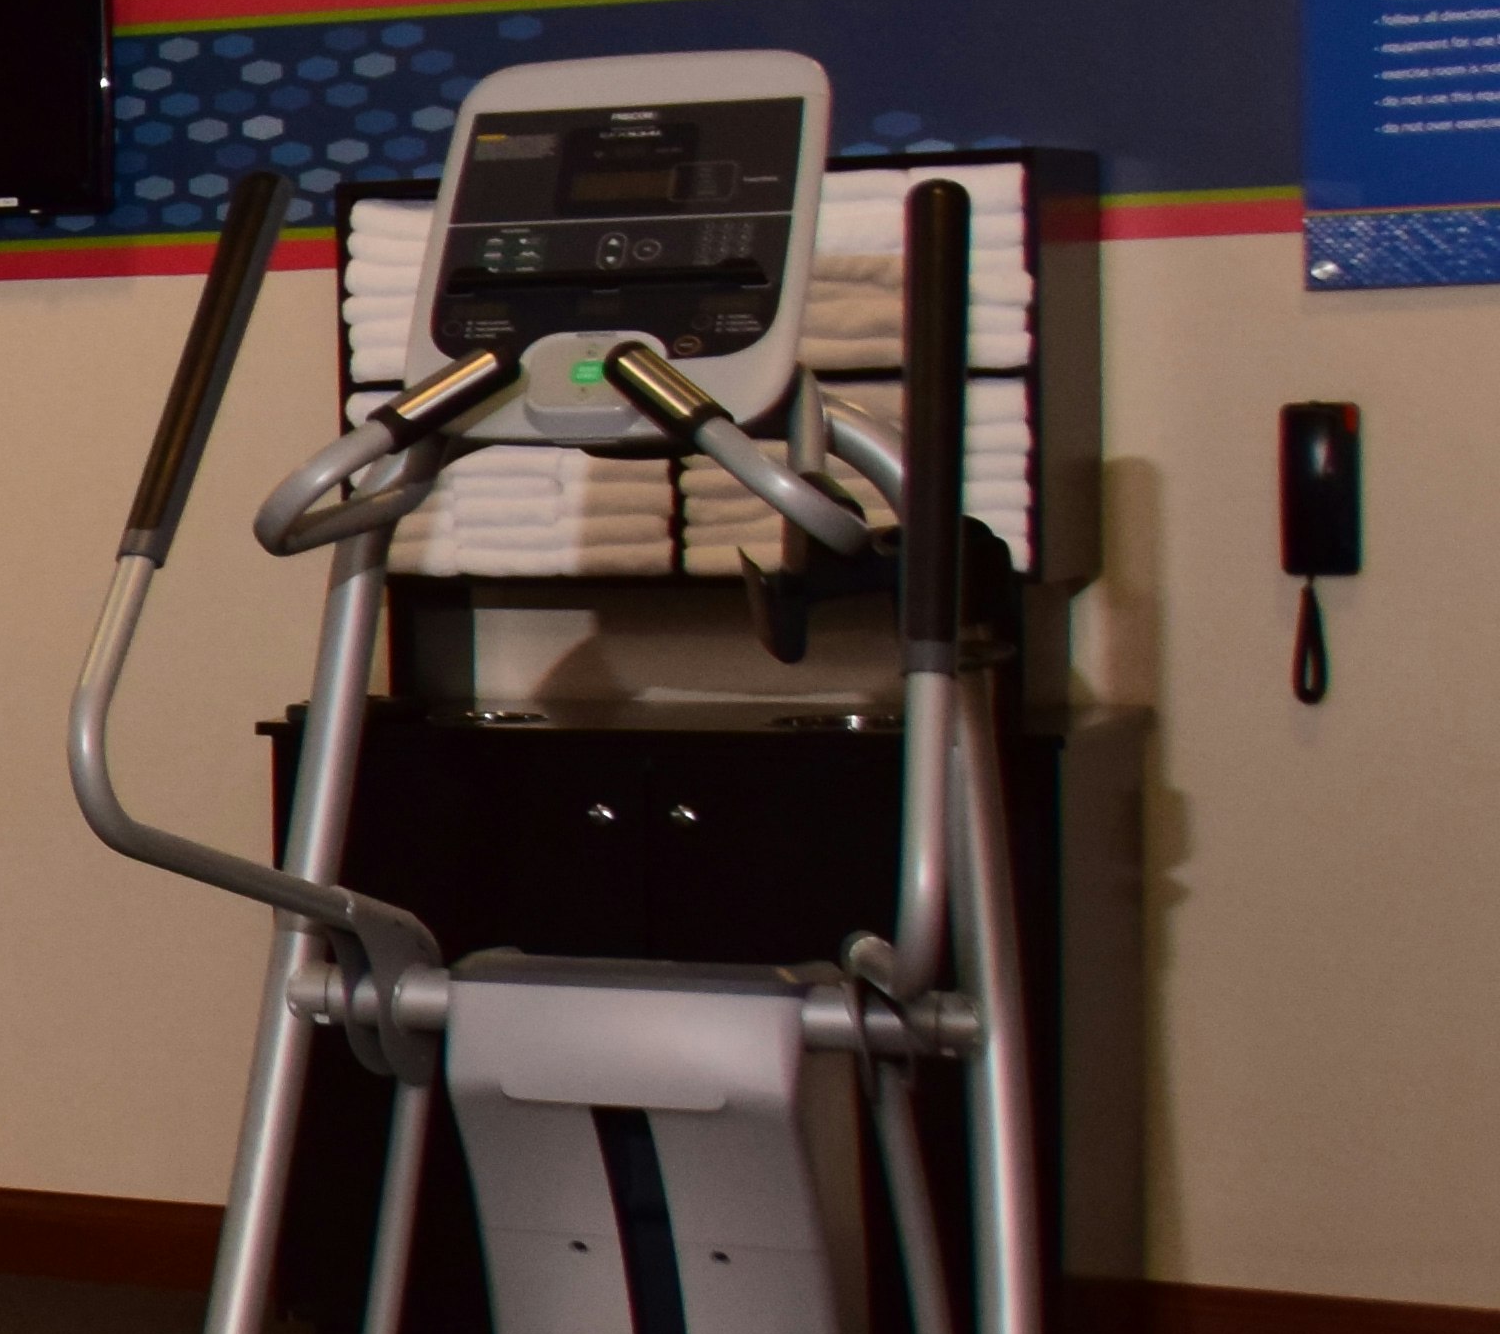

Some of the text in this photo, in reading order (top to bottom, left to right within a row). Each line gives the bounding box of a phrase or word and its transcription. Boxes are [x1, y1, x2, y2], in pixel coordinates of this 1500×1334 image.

[1381, 36, 1495, 54] equipment for use
[1381, 68, 1429, 79] exercise
[1431, 65, 1467, 76] room
[1382, 96, 1399, 107] do
[1400, 94, 1424, 106] not
[1426, 93, 1448, 105] use
[1450, 91, 1474, 103] this
[1382, 122, 1399, 134] do
[1401, 121, 1425, 133] not
